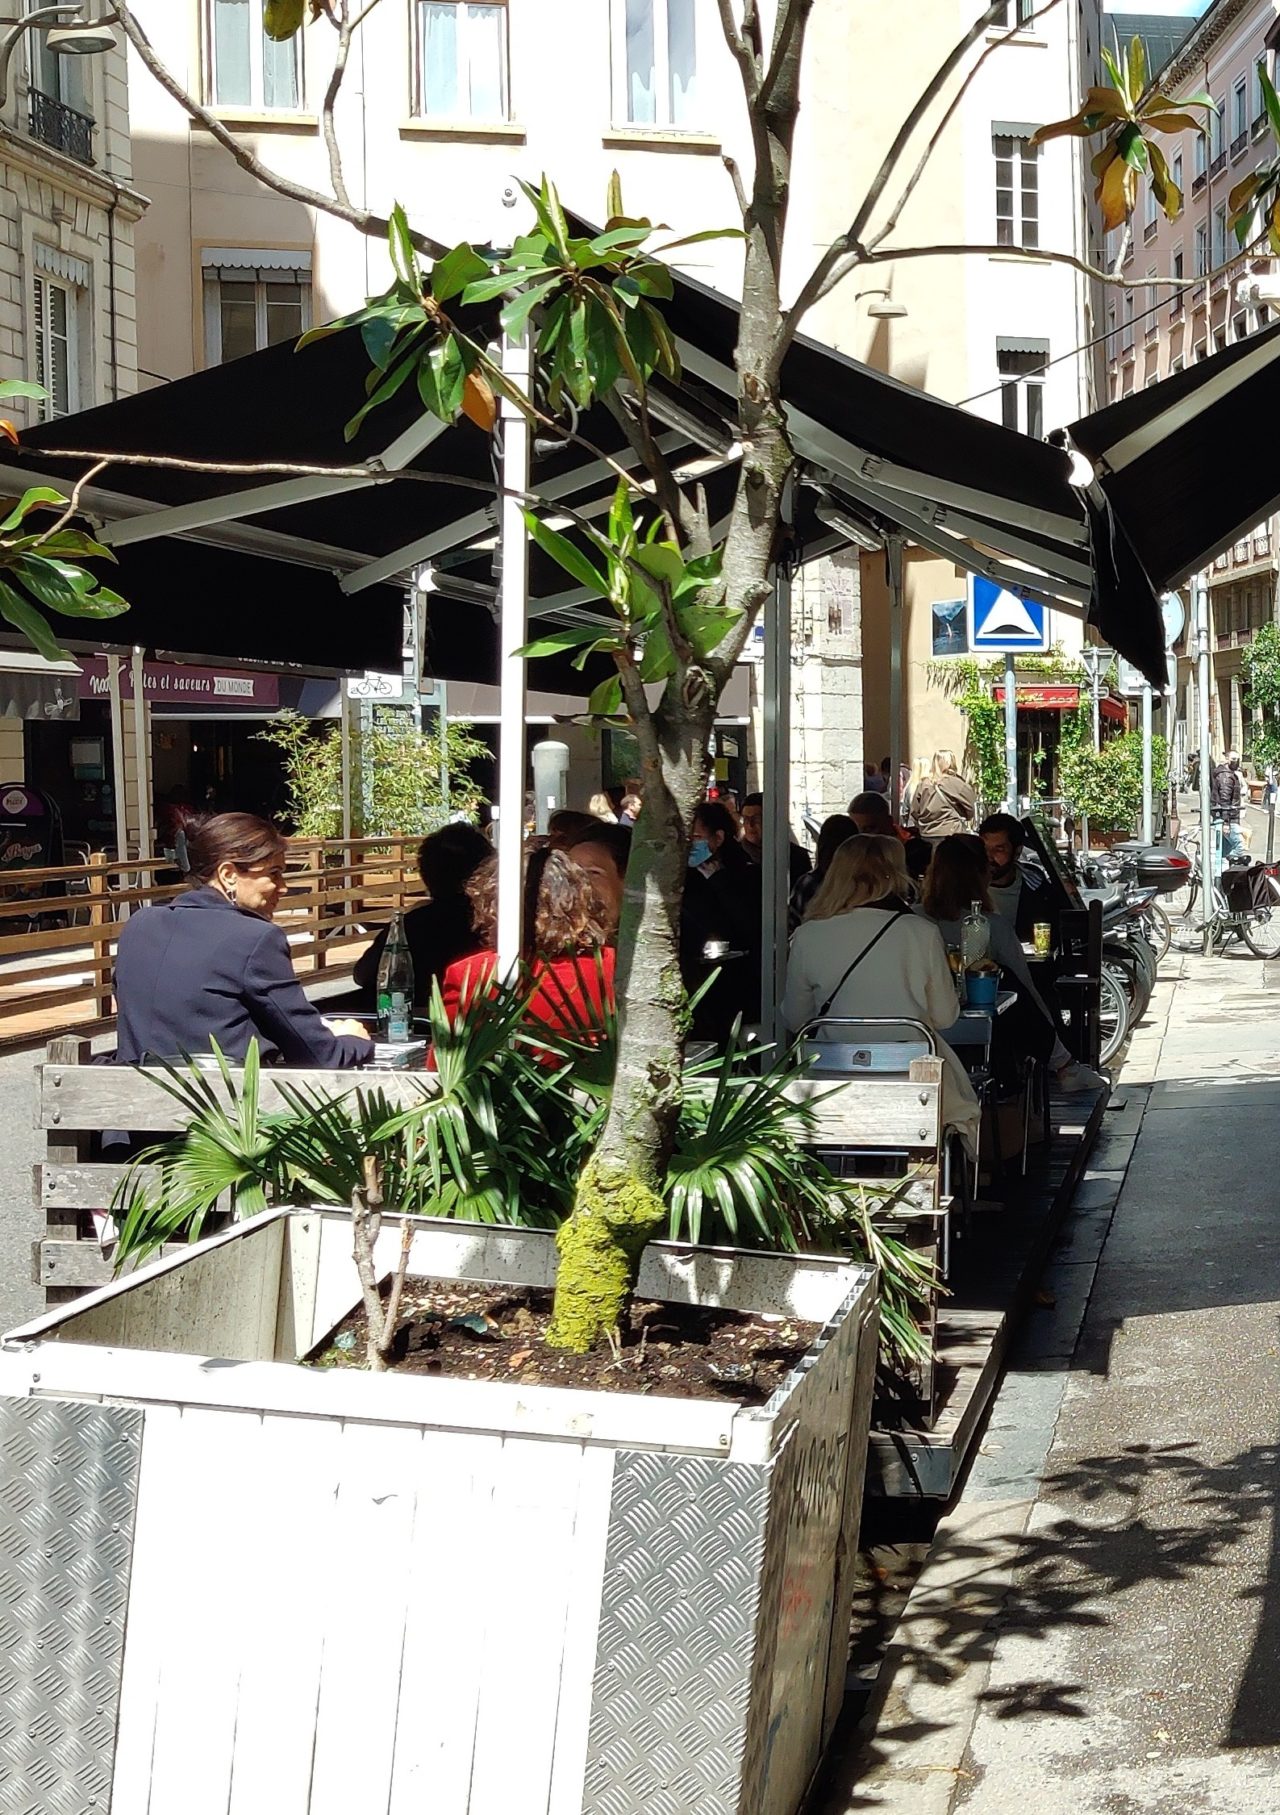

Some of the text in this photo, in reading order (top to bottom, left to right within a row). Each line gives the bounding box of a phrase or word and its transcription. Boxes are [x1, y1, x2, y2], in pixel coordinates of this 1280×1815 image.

[173, 675, 211, 692] saveurs
[216, 680, 226, 693] DU
[227, 680, 252, 694] MONDE
